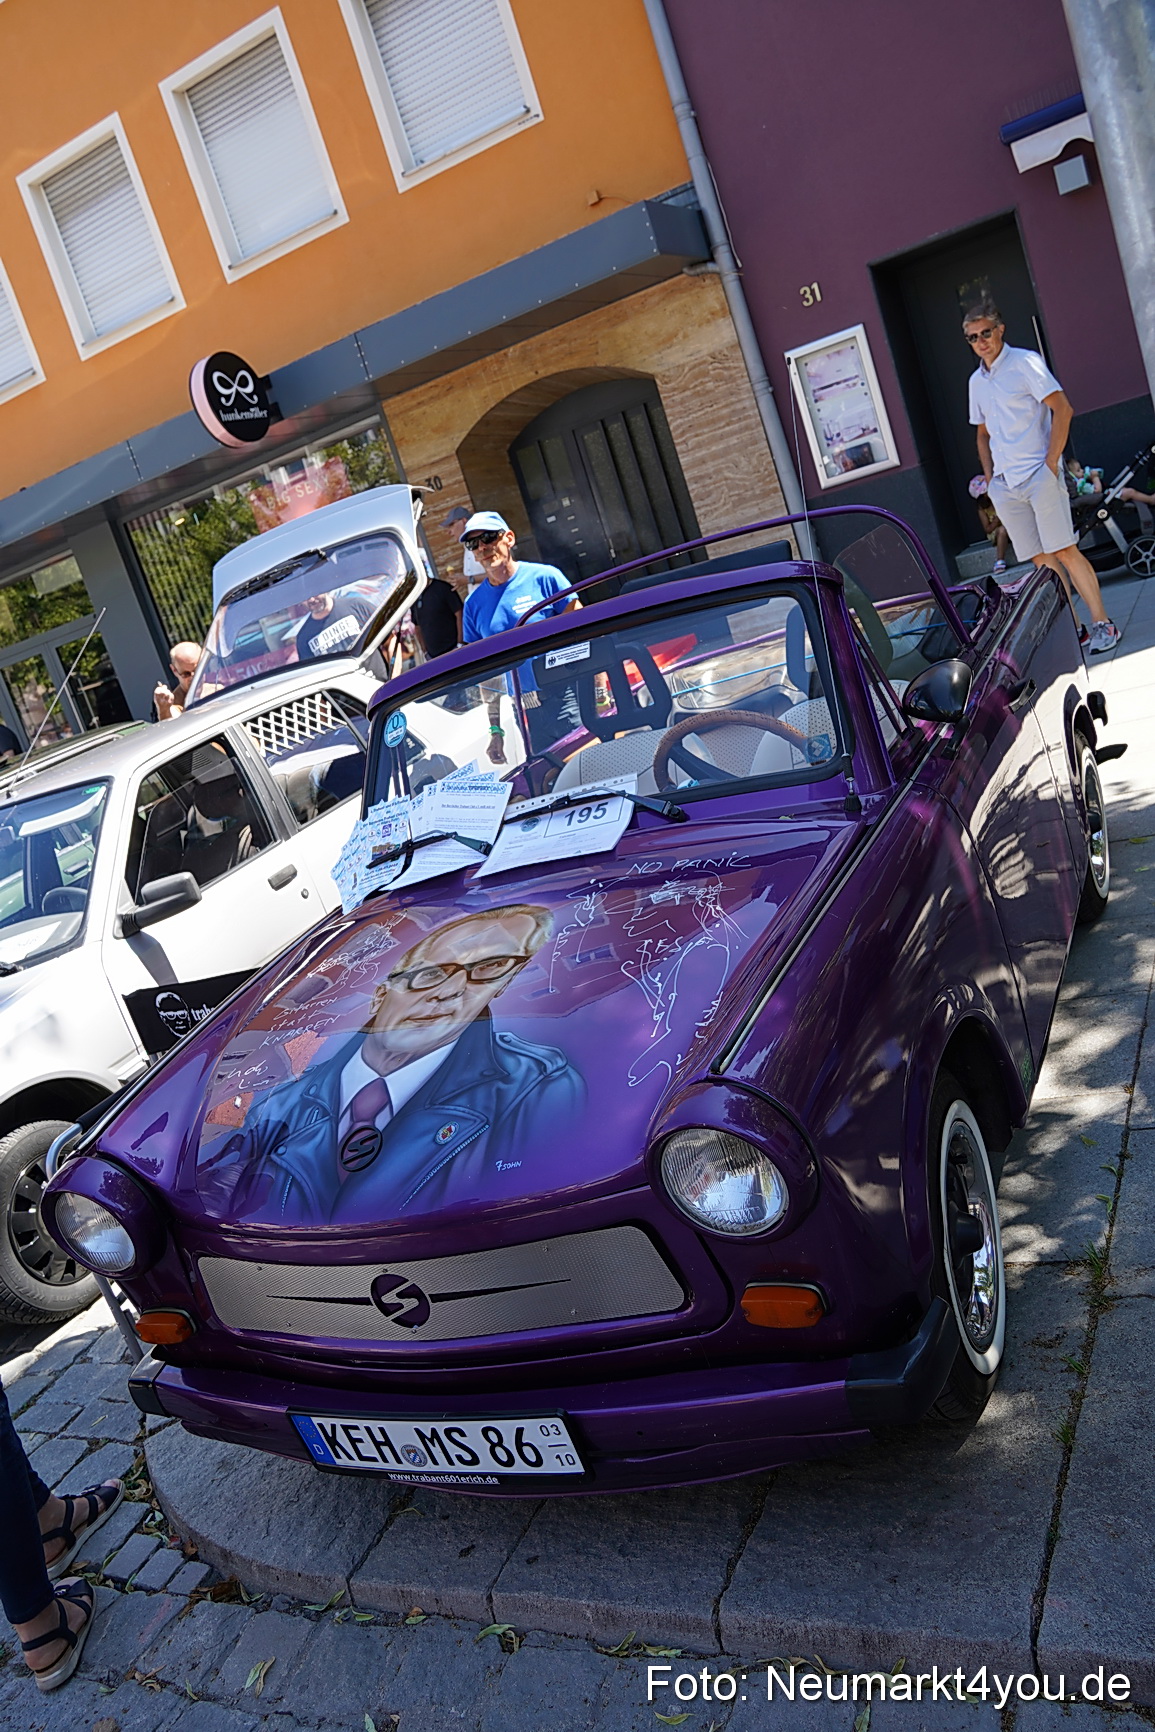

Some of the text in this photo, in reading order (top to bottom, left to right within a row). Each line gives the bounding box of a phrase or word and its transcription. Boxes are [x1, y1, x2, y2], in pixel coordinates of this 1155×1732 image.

[799, 281, 822, 307] 31
[425, 475, 443, 491] 30
[266, 474, 329, 510] BIG SEXY
[564, 801, 609, 827] 195
[626, 861, 663, 875] NO
[539, 1424, 562, 1437] 03
[316, 1421, 403, 1465] KEH
[413, 1425, 481, 1467] MS
[481, 1425, 544, 1468] 86
[554, 1453, 577, 1467] 10
[387, 1472, 499, 1485] www.trabant601erich.de
